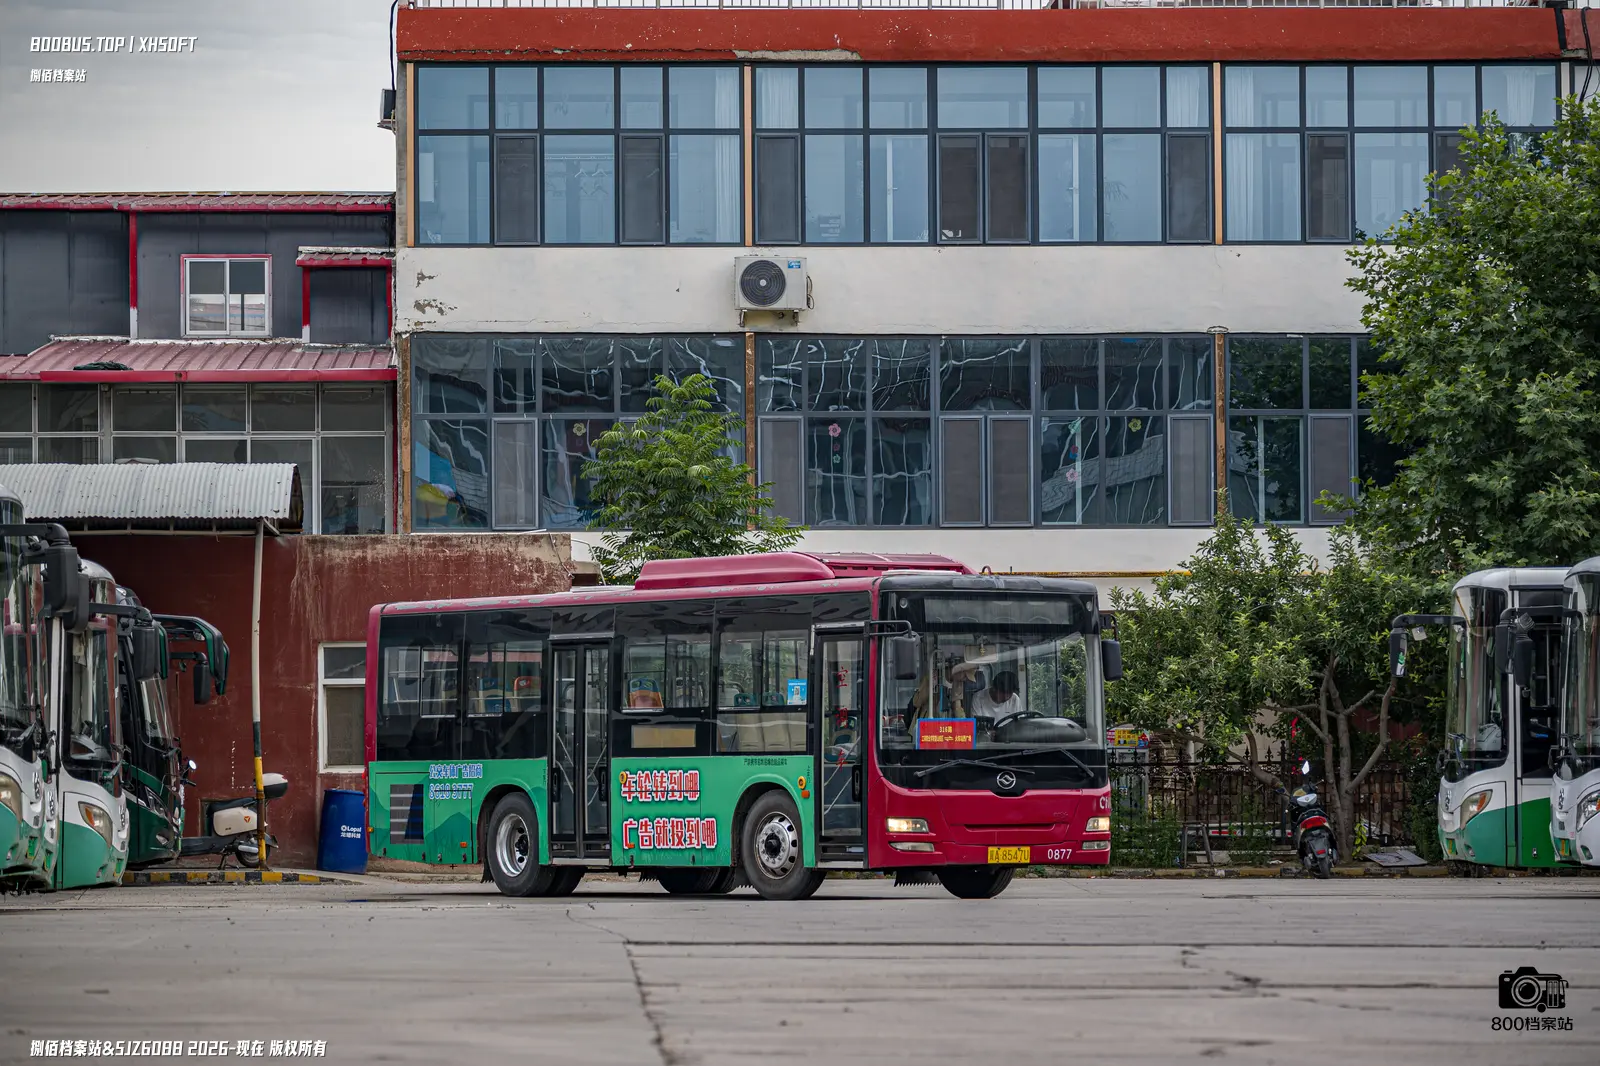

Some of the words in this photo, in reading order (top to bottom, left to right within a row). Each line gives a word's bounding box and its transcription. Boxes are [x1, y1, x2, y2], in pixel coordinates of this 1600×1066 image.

[621, 770, 699, 801] 车轮转到哪
[623, 818, 717, 849] 广告就投到哪
[1047, 848, 1072, 860] 0877
